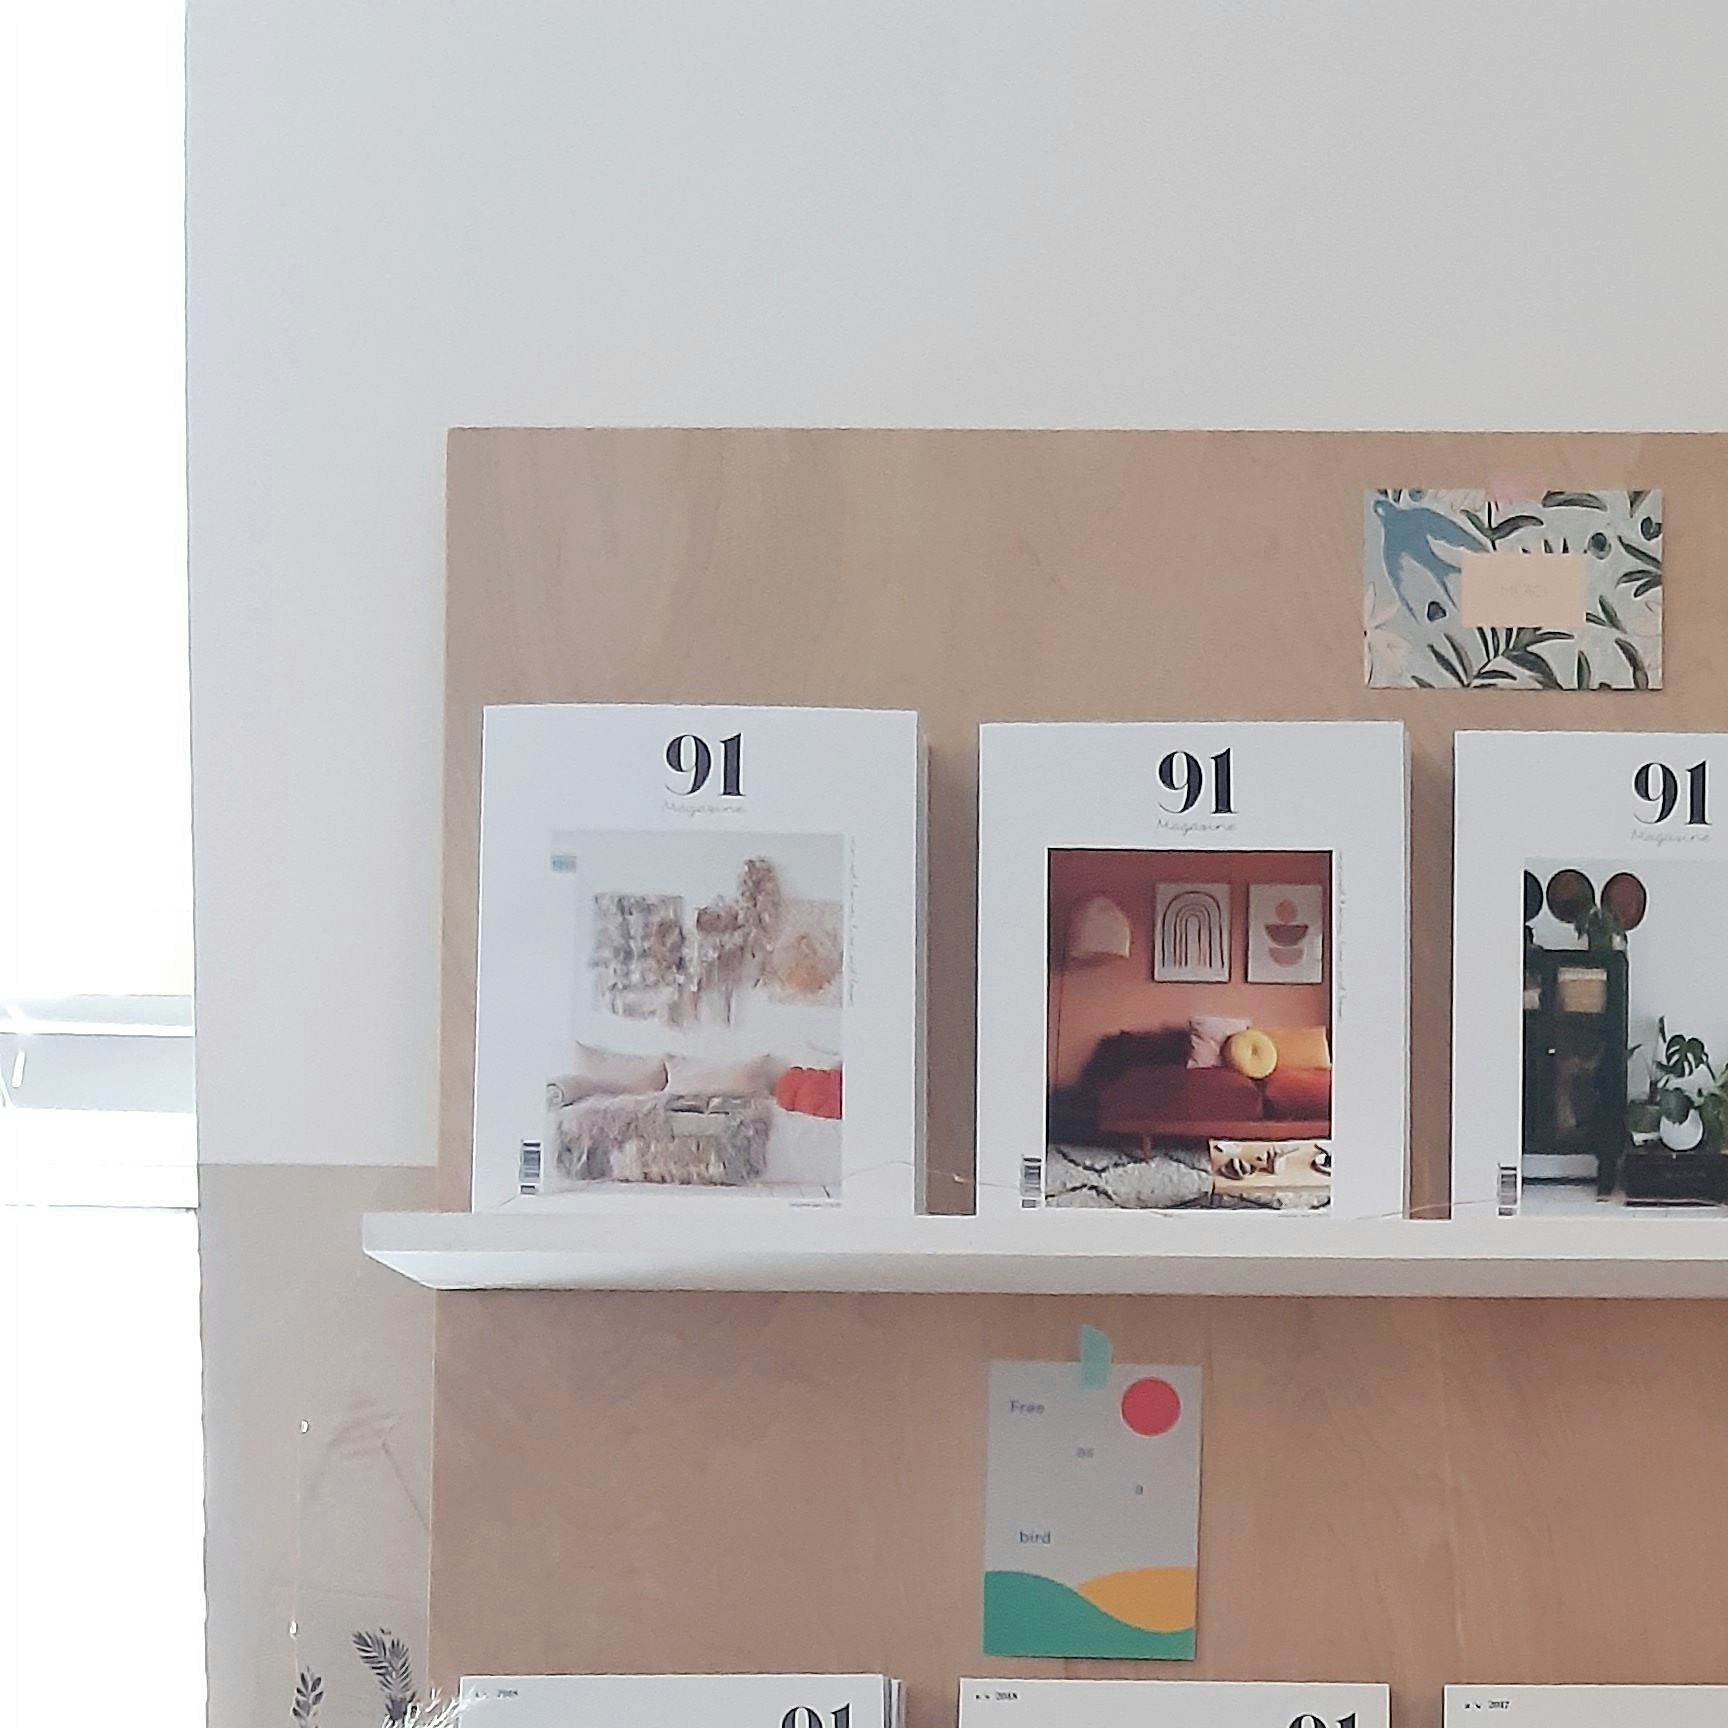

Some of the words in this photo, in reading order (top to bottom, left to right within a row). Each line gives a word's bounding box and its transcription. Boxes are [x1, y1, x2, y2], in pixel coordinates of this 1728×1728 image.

[666, 733, 744, 797] 91
[1159, 748, 1236, 814] 91
[1635, 761, 1710, 825] 91
[1009, 1399, 1045, 1415] Free
[1076, 1447, 1095, 1459] as
[1018, 1530, 1052, 1545] bird
